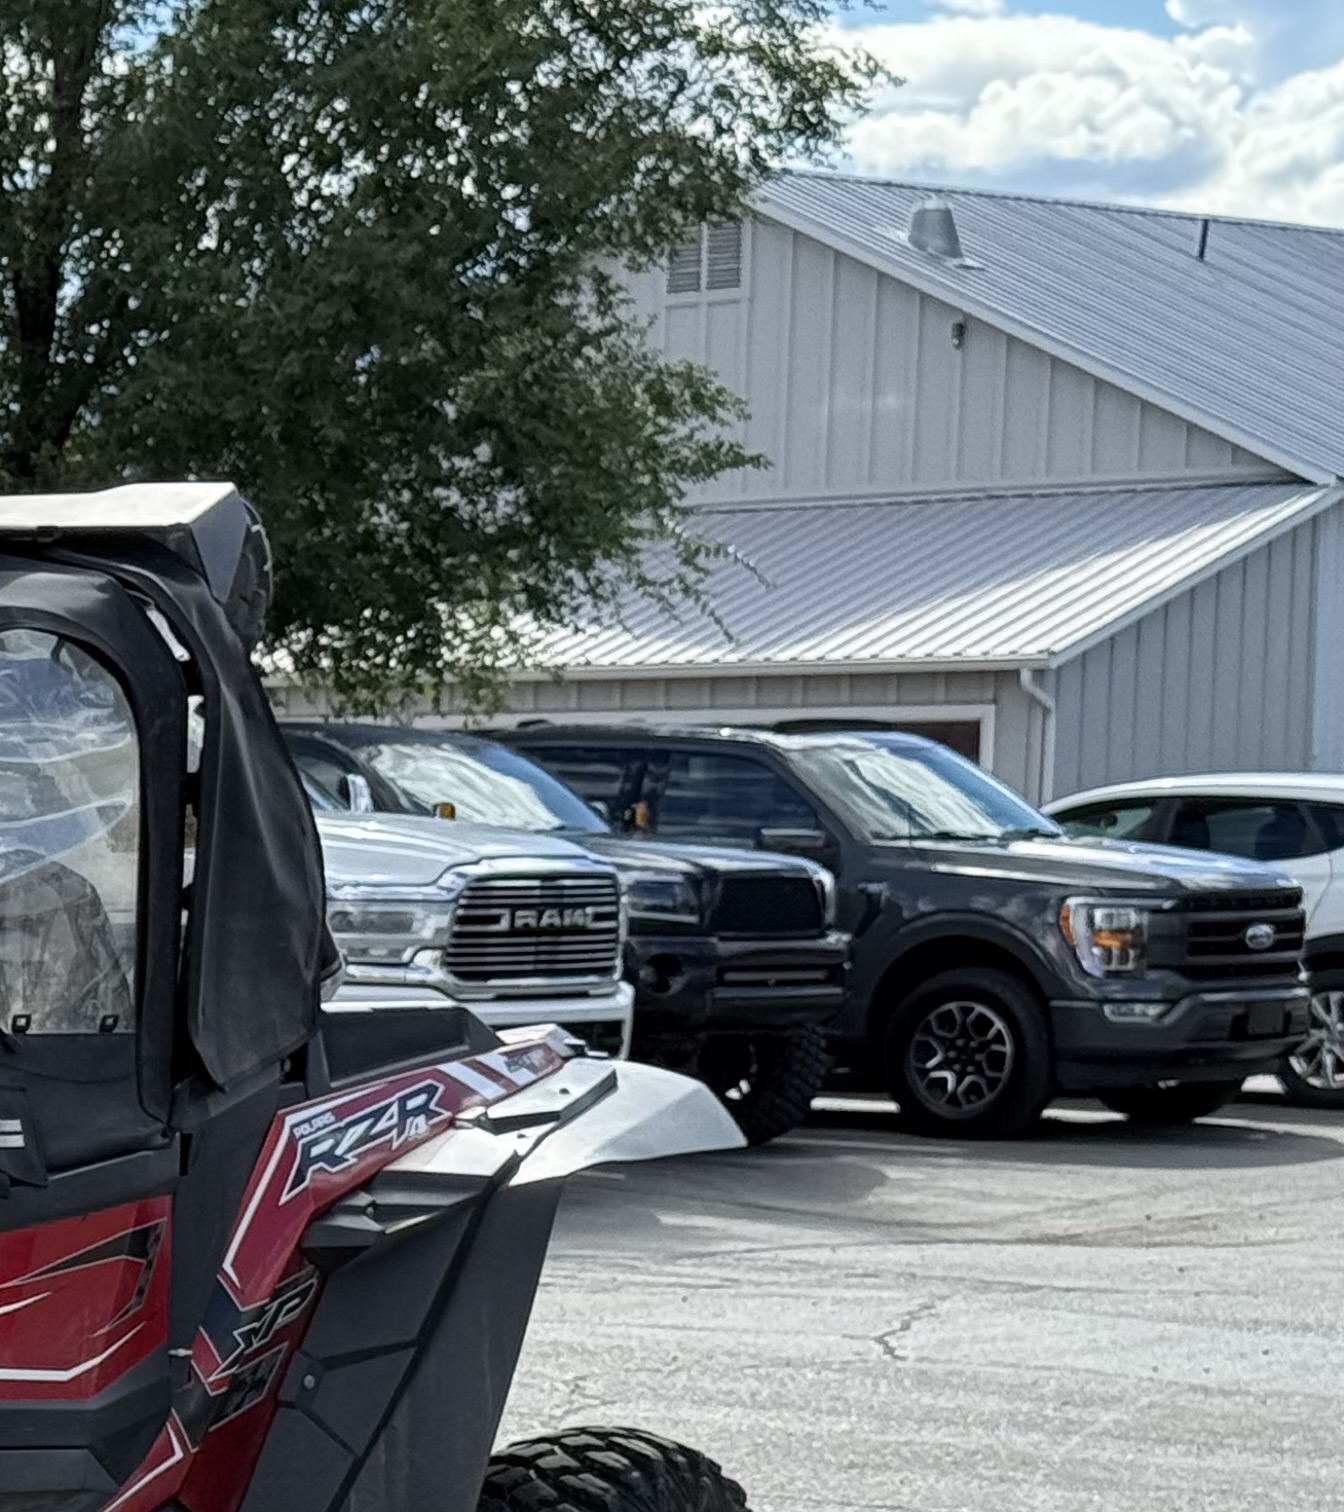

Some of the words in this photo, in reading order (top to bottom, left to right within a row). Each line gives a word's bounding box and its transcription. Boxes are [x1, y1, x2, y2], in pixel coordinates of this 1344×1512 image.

[513, 908, 591, 929] RAM
[293, 1111, 336, 1139] POLARIS
[278, 1079, 453, 1207] RZR
